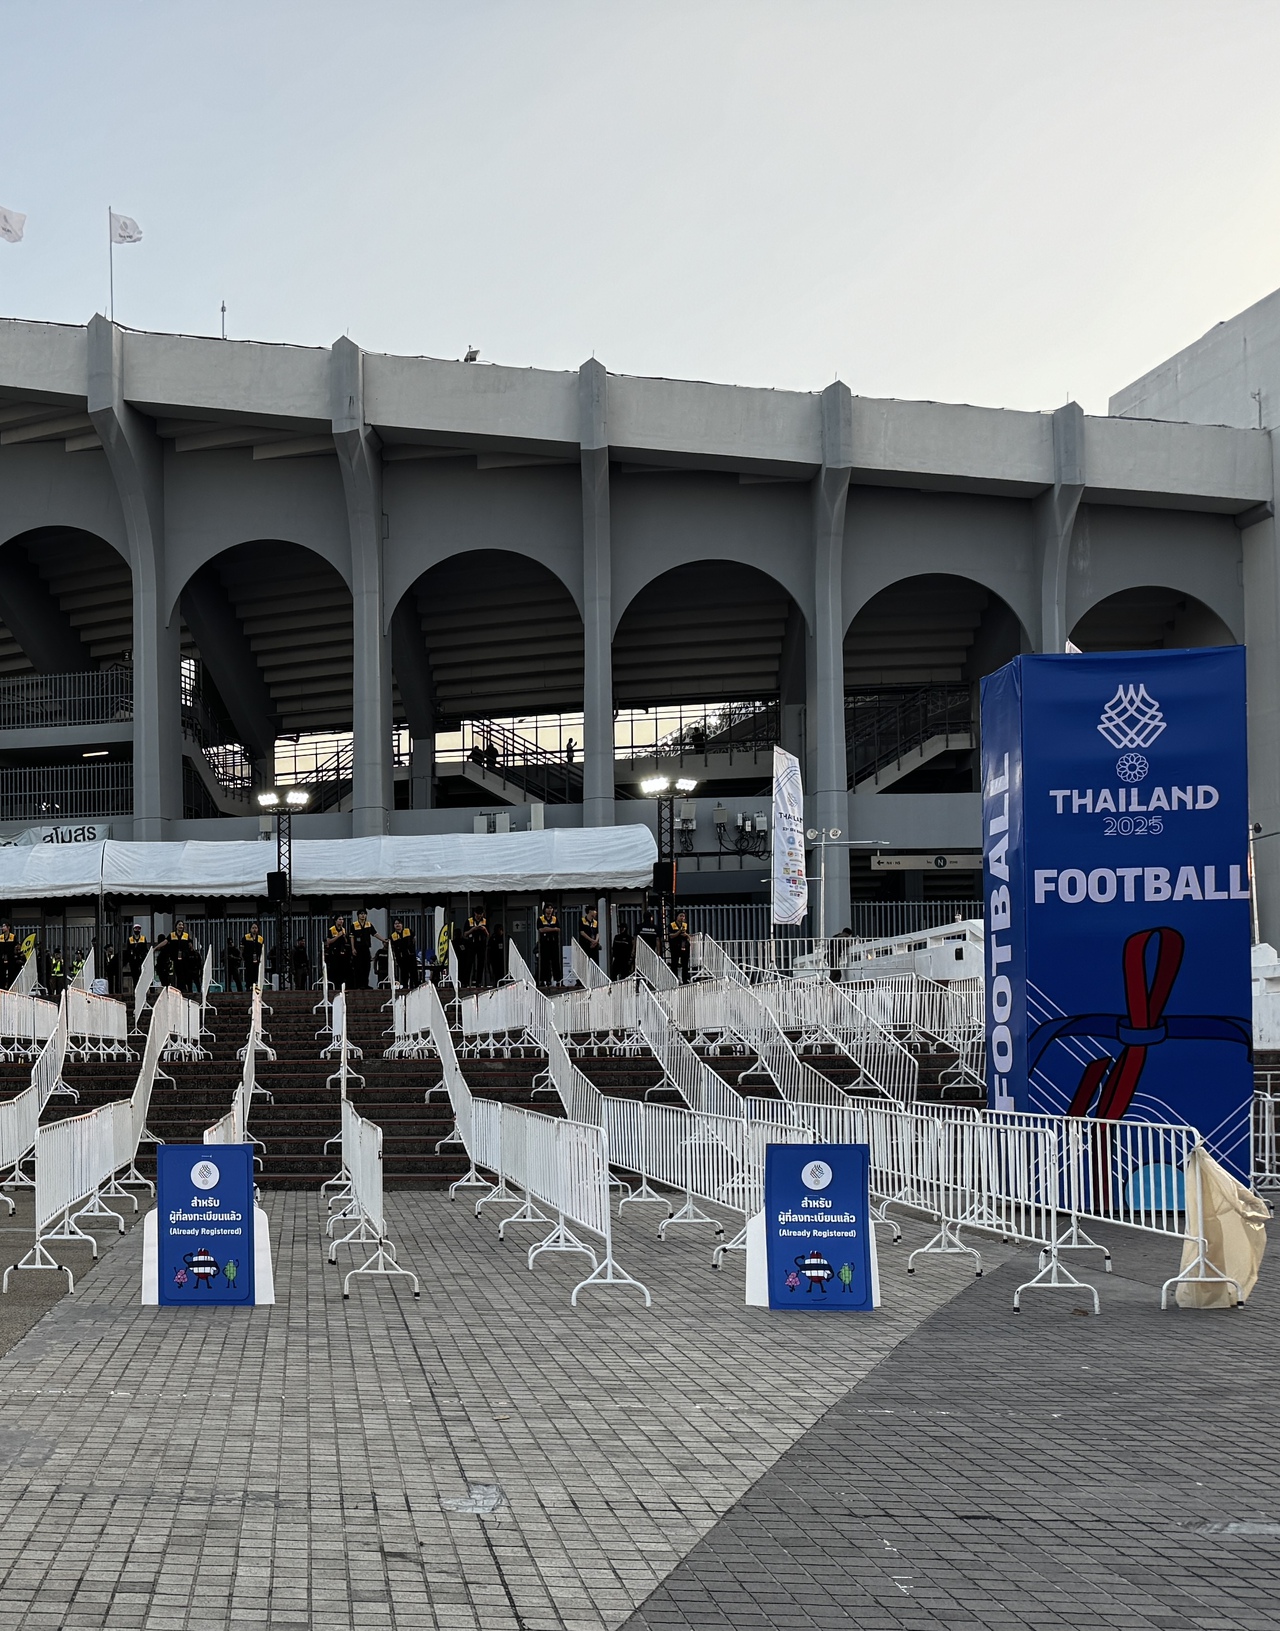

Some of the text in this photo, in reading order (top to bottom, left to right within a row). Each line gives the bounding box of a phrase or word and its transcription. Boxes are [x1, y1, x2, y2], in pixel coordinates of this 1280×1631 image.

[1049, 784, 1219, 815] THAILAND
[1103, 816, 1164, 836] 2025
[1034, 865, 1250, 904] FOOTBALL
[989, 752, 1015, 1112] FOOTBALL
[191, 1196, 220, 1207] สำหรับ
[801, 1197, 832, 1208] สำหรับ
[169, 1209, 242, 1224] ผู้ที่ลงทะเบียนแล้ว
[778, 1209, 856, 1225] ผู้ที่ลงทะเบียนแล้ว
[169, 1227, 242, 1236] (Already Registered)
[779, 1229, 856, 1238] (Already Registered)
